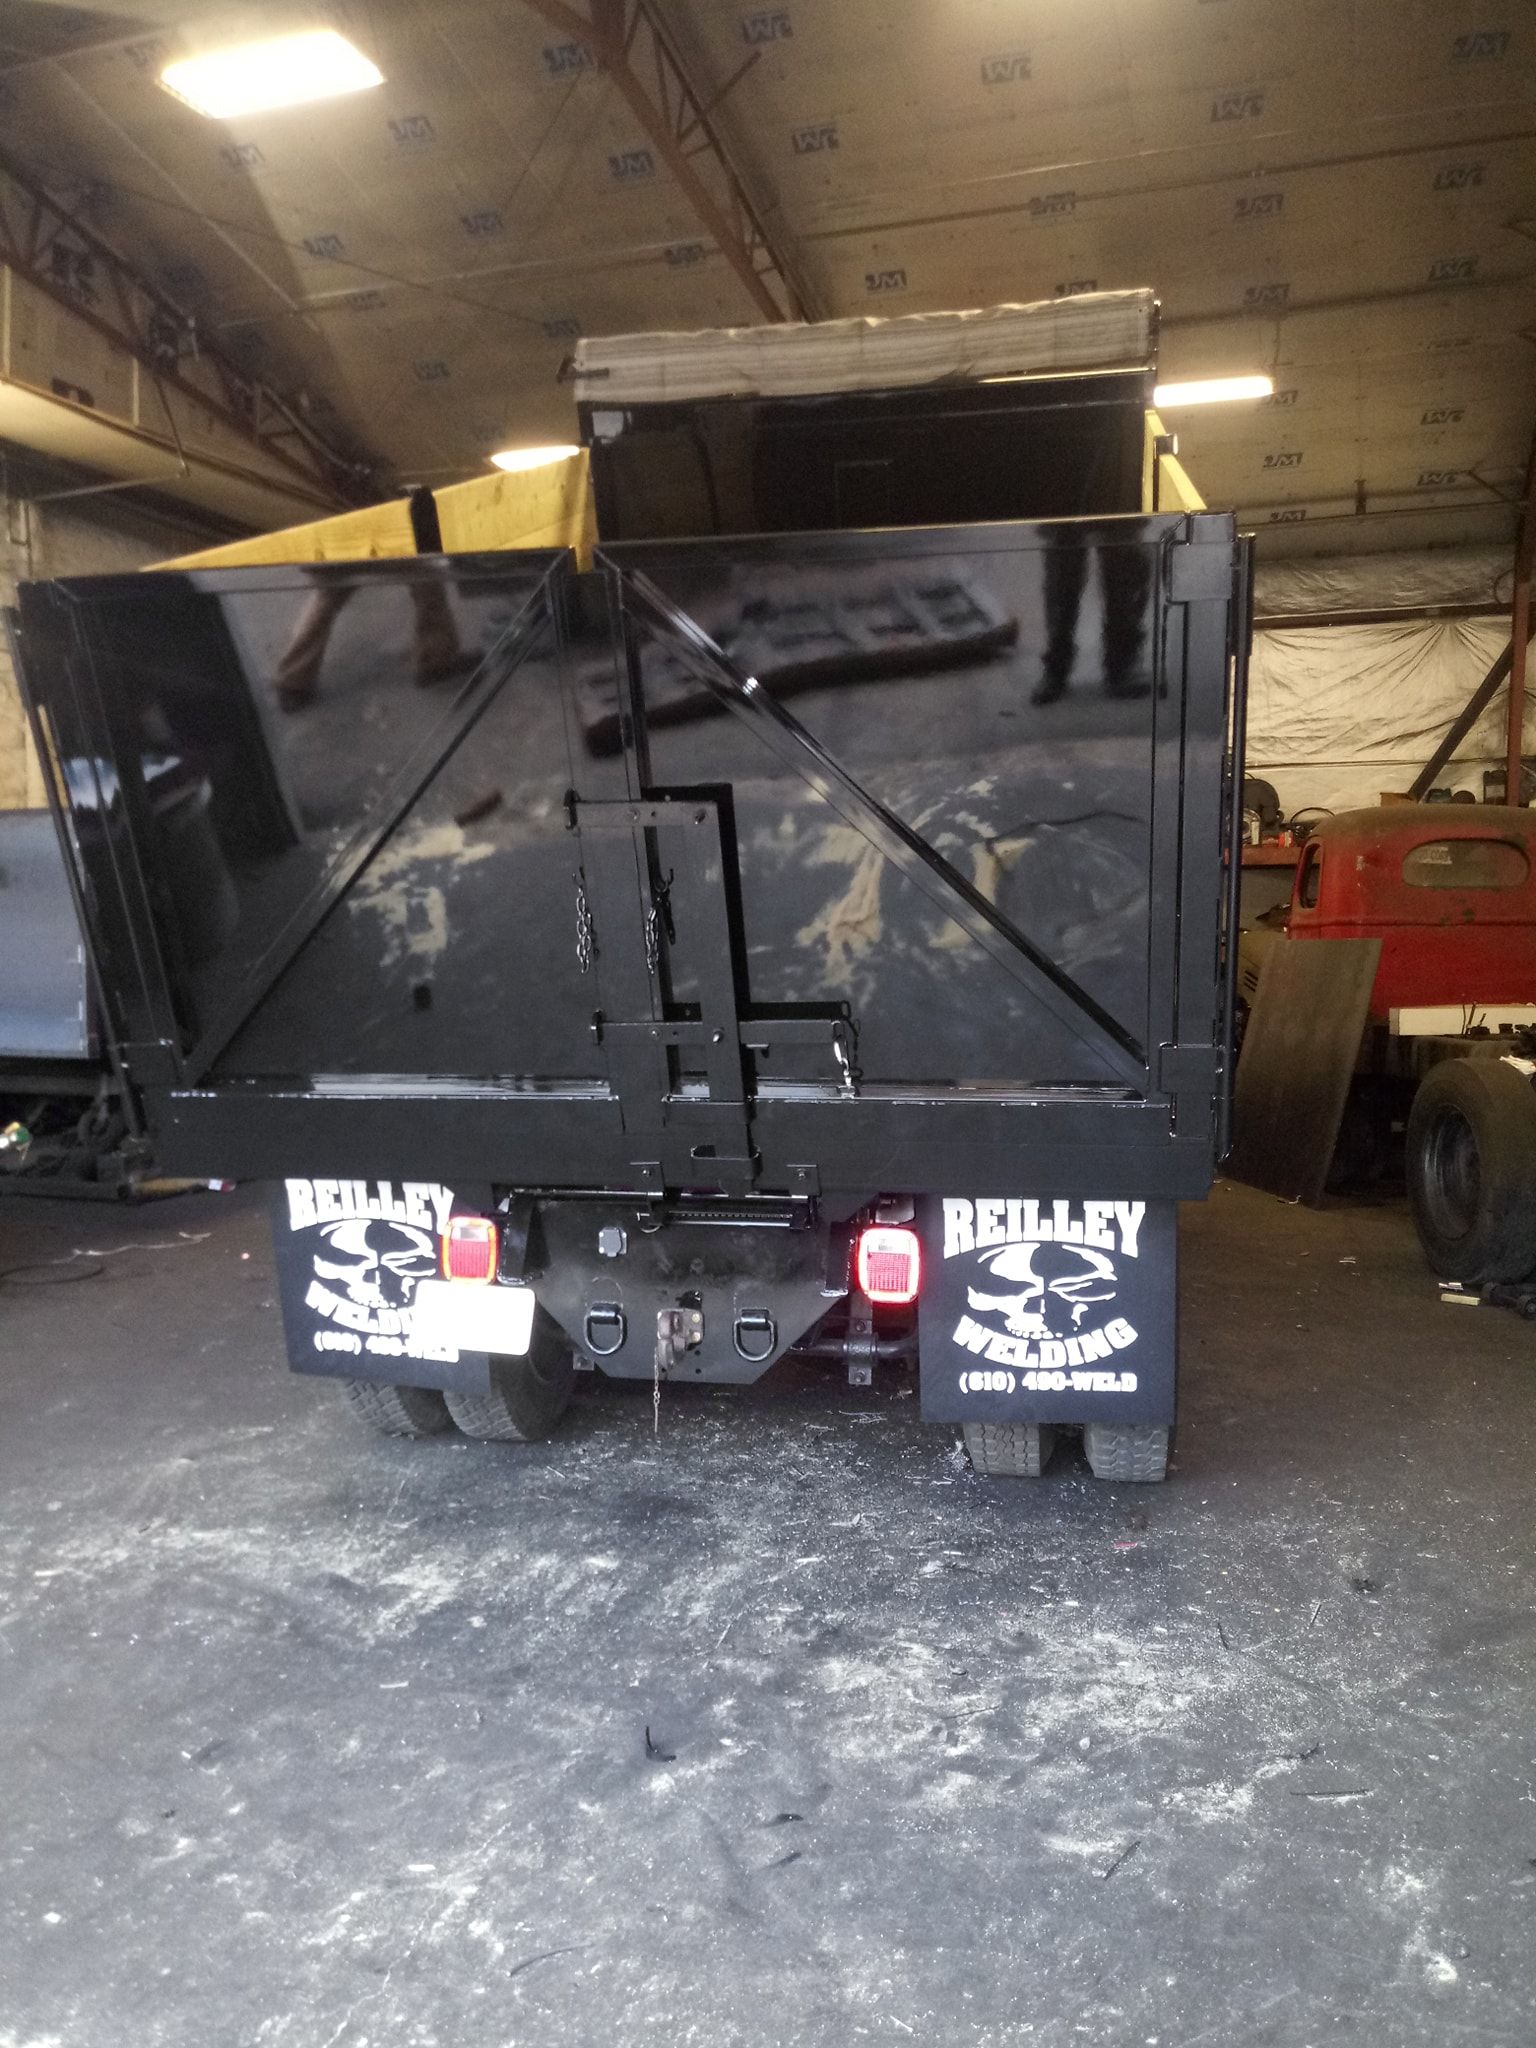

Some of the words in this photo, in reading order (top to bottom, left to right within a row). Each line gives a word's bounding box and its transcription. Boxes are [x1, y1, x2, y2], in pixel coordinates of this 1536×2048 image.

[981, 55, 1032, 85] JM
[389, 116, 435, 142] JM
[792, 122, 839, 155] JM
[609, 150, 655, 182] JM
[865, 269, 907, 291] JM
[1420, 408, 1465, 426] JM
[1263, 452, 1304, 469] JM
[1270, 509, 1310, 522] JM
[285, 1178, 455, 1237] REILLEY
[943, 1197, 1147, 1260] REILLEY
[952, 1314, 1139, 1369] WELDING
[959, 1371, 1016, 1395] (610)
